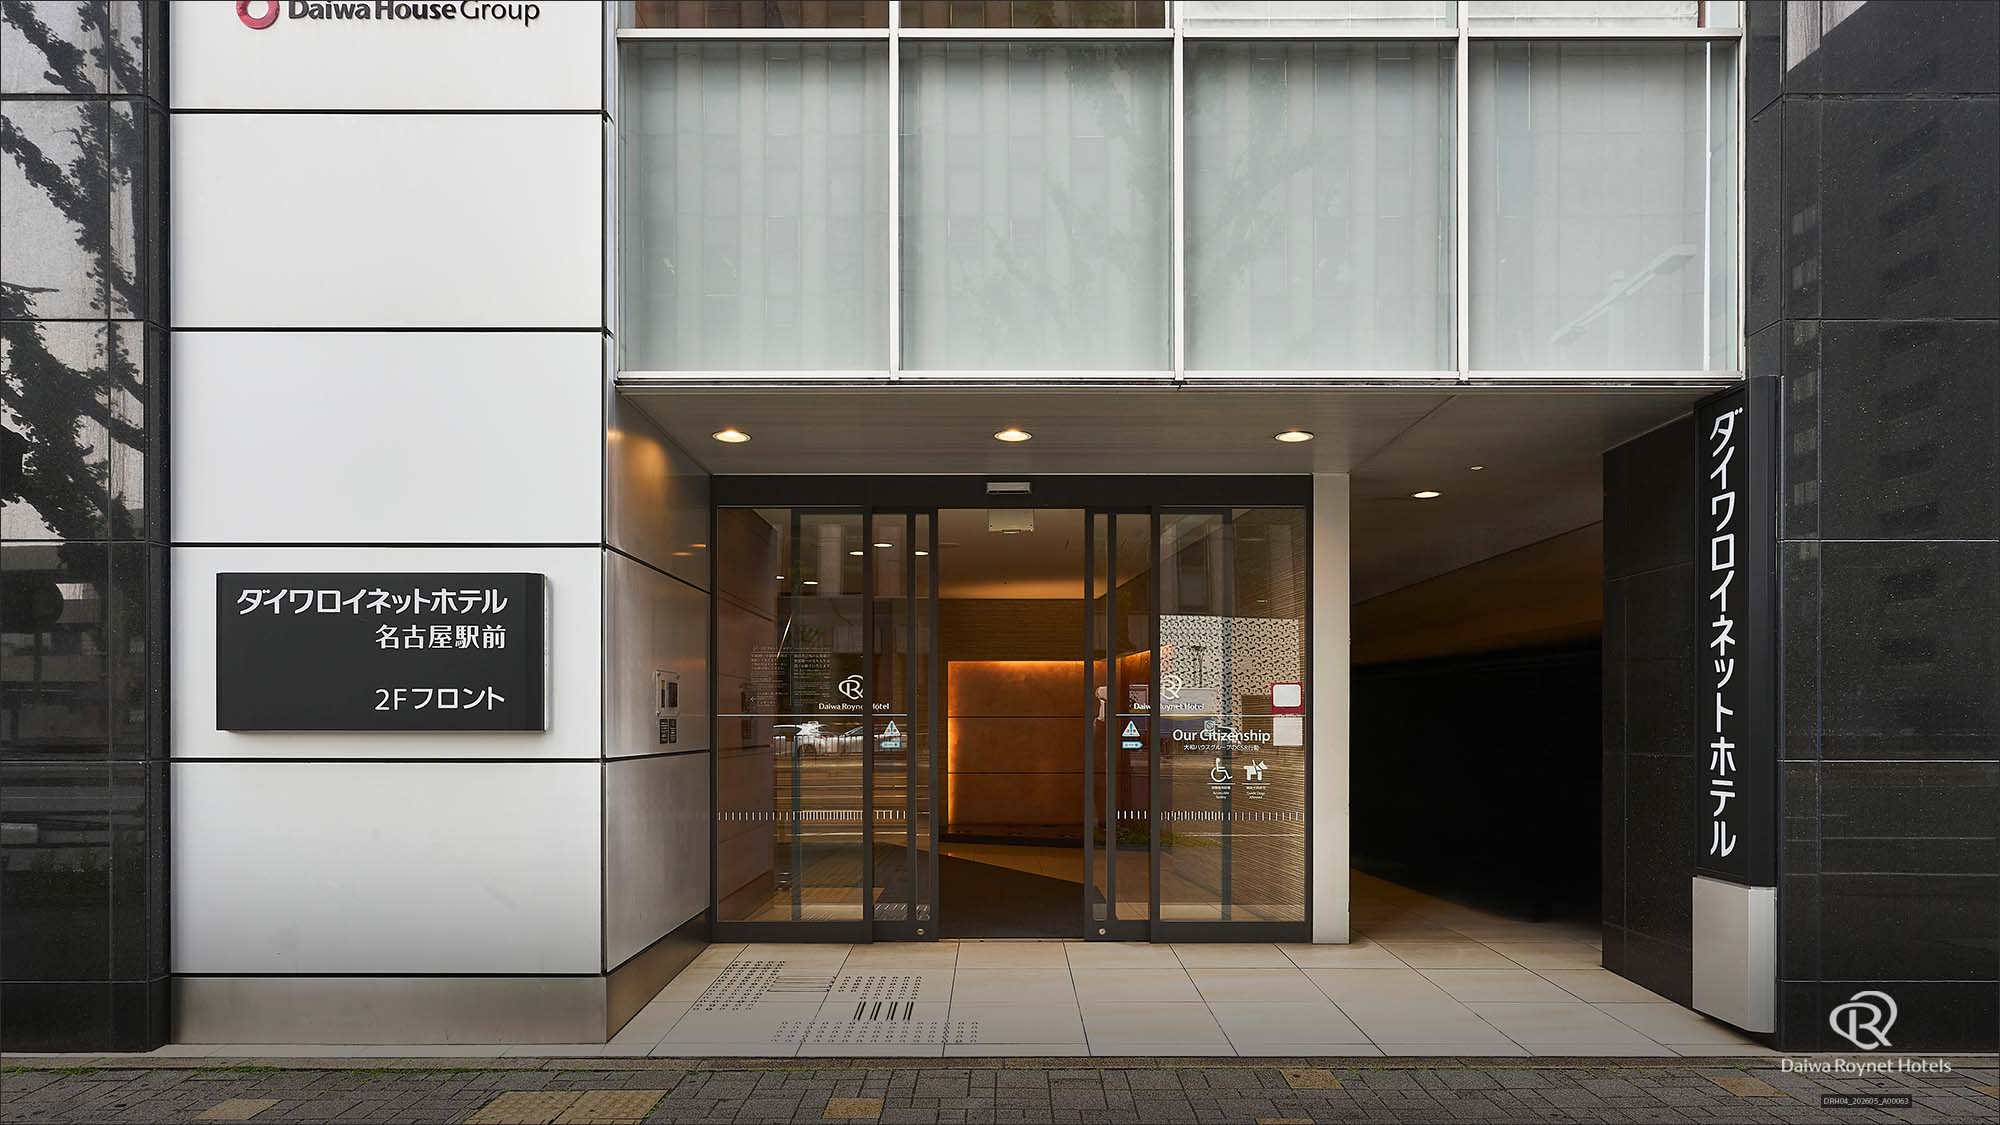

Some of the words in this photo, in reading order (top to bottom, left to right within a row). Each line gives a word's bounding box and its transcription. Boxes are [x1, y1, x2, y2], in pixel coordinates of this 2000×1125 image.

[288, 0, 371, 20] Daiwa
[375, 0, 457, 20] House
[460, 0, 541, 27] Group
[237, 588, 508, 615] ダイワロイネットホテル
[375, 624, 507, 650] 名古屋駅前
[1709, 406, 1744, 858] ダイワロイネットホテル
[374, 686, 505, 711] 2Fフロント
[841, 703, 864, 711] Royn
[1133, 702, 1152, 710] Daiw
[1172, 729, 1198, 741] Our
[1199, 729, 1271, 744] Citizenship
